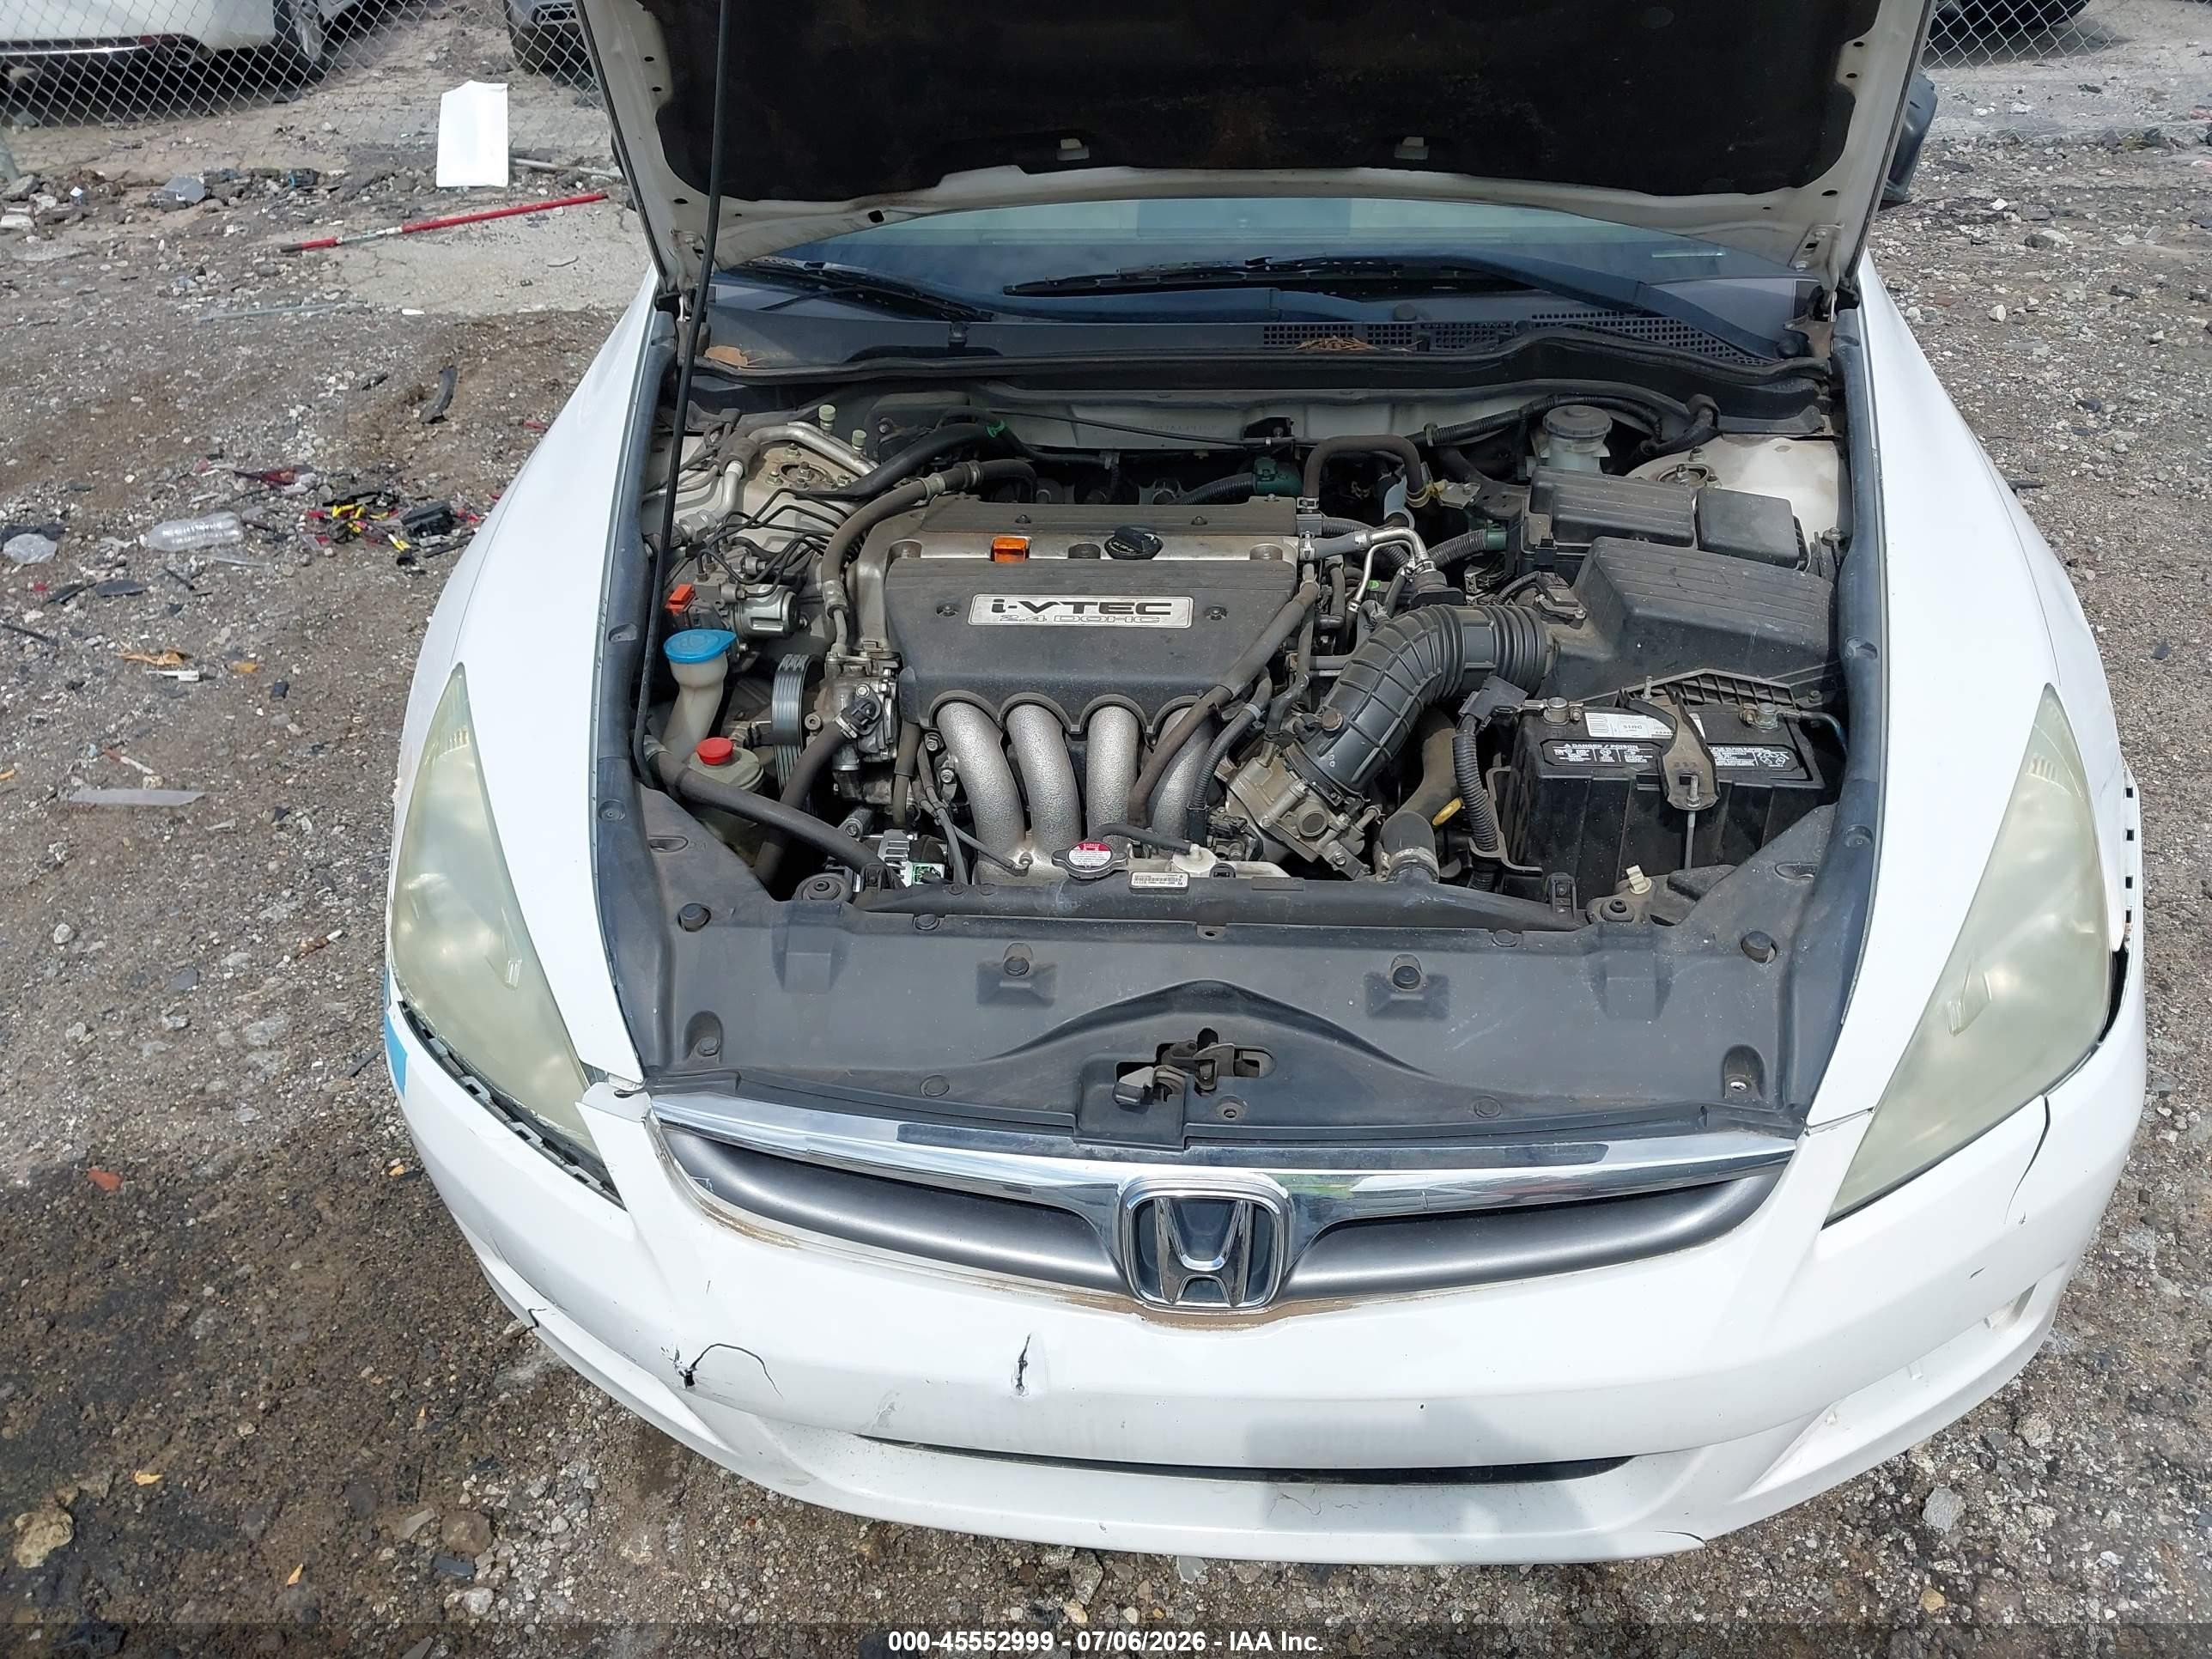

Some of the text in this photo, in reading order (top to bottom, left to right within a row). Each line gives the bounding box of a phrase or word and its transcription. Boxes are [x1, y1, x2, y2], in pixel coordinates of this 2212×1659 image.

[991, 599, 1172, 616] i-VTEC
[999, 614, 1161, 623] 2.4 DOHC
